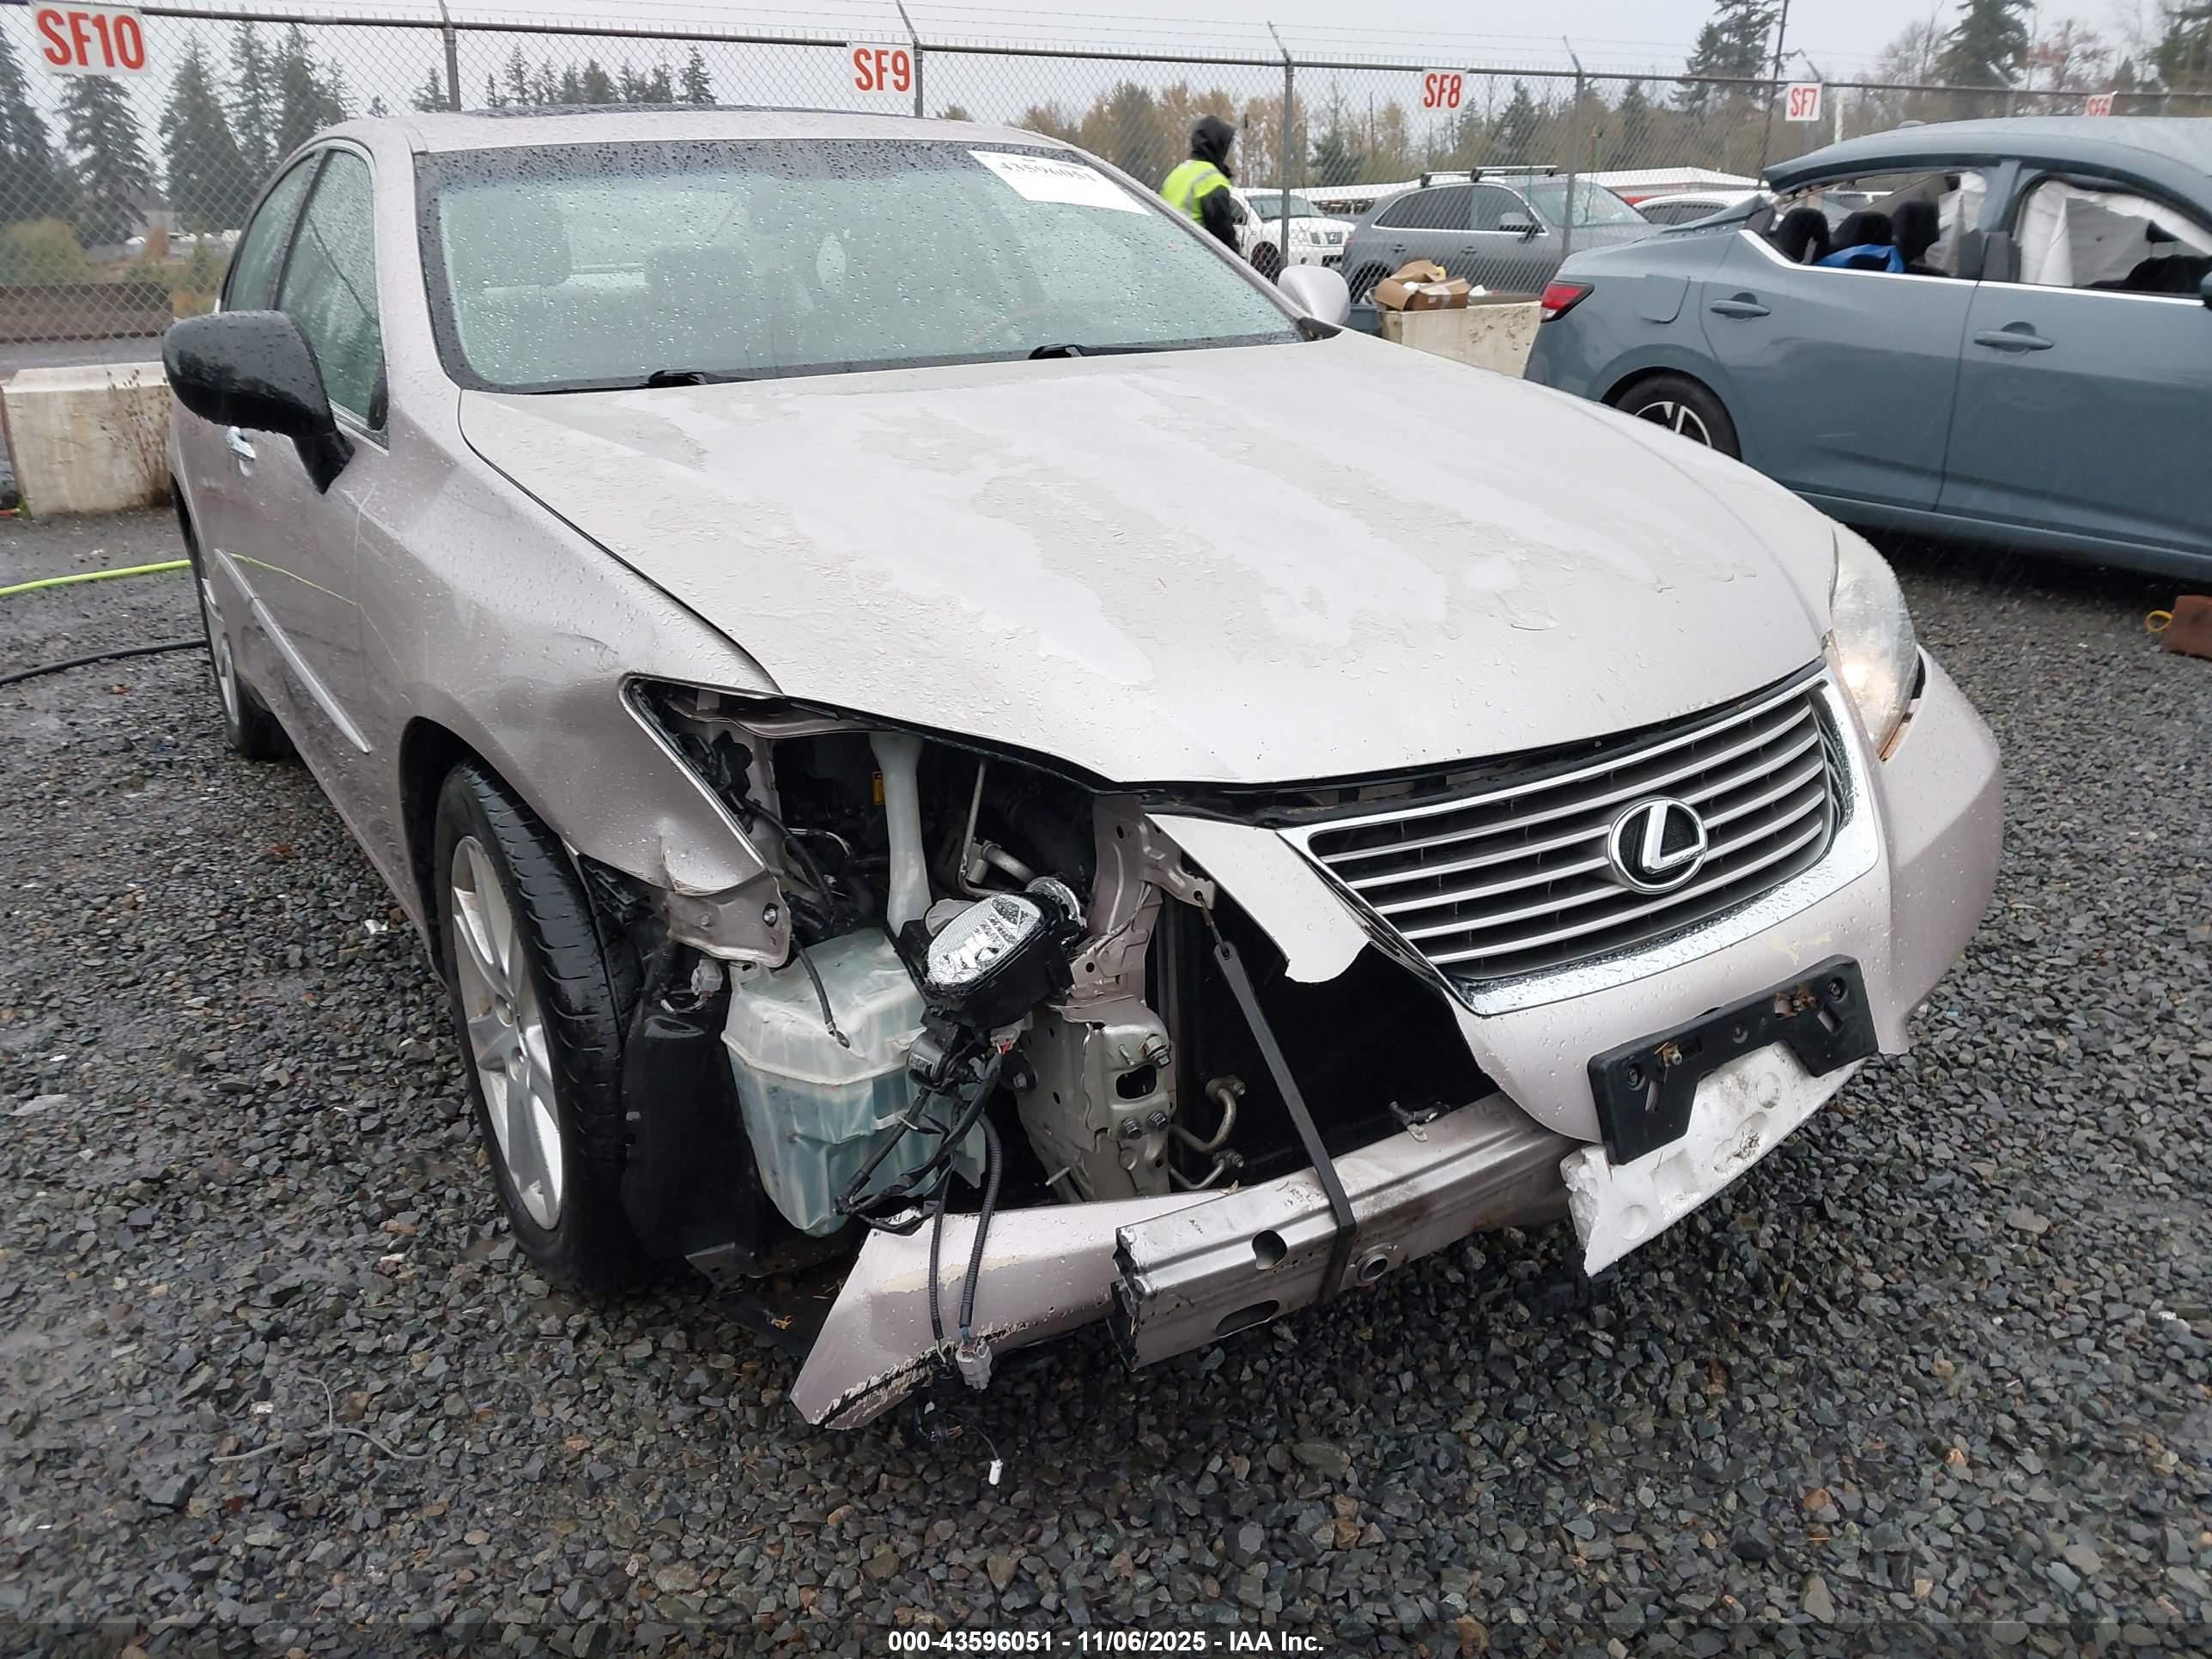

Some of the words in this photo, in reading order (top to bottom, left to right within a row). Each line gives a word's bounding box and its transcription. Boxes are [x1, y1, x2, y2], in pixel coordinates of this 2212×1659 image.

[37, 9, 144, 70] SF10
[854, 48, 910, 91] SF9
[1424, 73, 1462, 108] SF8
[1790, 88, 1817, 117] SF7
